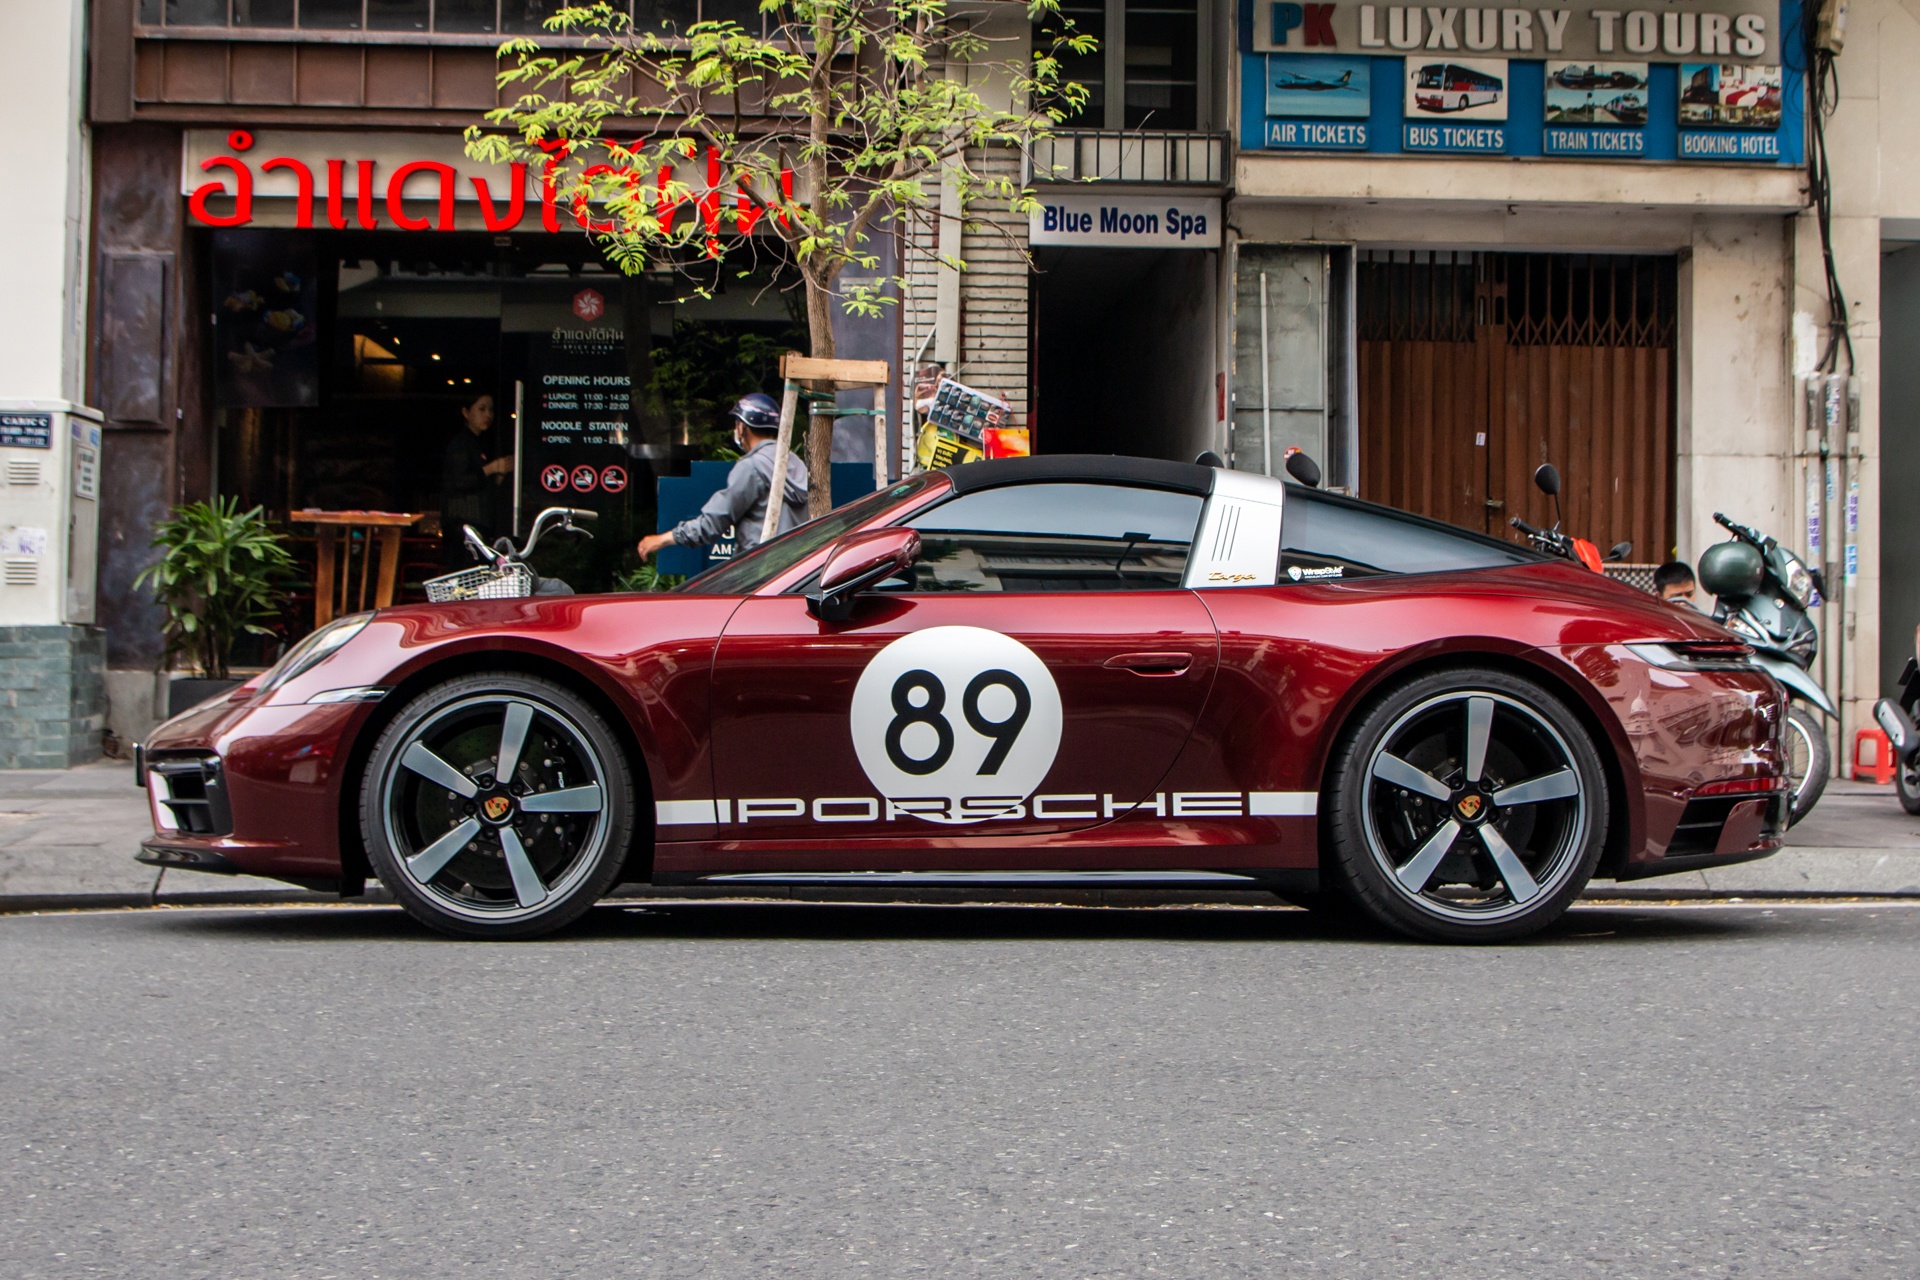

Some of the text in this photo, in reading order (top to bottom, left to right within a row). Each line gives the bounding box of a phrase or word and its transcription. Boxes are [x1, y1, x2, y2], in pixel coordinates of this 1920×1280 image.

[1271, 3, 1765, 56] PK LUXURY TOURS
[1271, 124, 1366, 144] AIR TICKETS
[1410, 127, 1503, 148] BUS TICKETS
[1551, 132, 1643, 150] TRAIN TICKETS
[1684, 135, 1780, 155] BOOKING HOTEL
[1044, 206, 1206, 240] Blue Moon Spa
[543, 375, 631, 386] OPENING HOURS
[548, 402, 579, 410] DINNER:
[584, 402, 603, 410] 17:30
[584, 393, 604, 401] 11:00
[610, 393, 630, 401] 14:30
[542, 421, 628, 431] NOODLE STATION
[548, 436, 571, 444] OPEN:
[583, 436, 602, 444] 11:00
[1208, 572, 1256, 583] Targa
[885, 669, 1031, 776] 89
[737, 793, 1243, 823] PORSCHE
